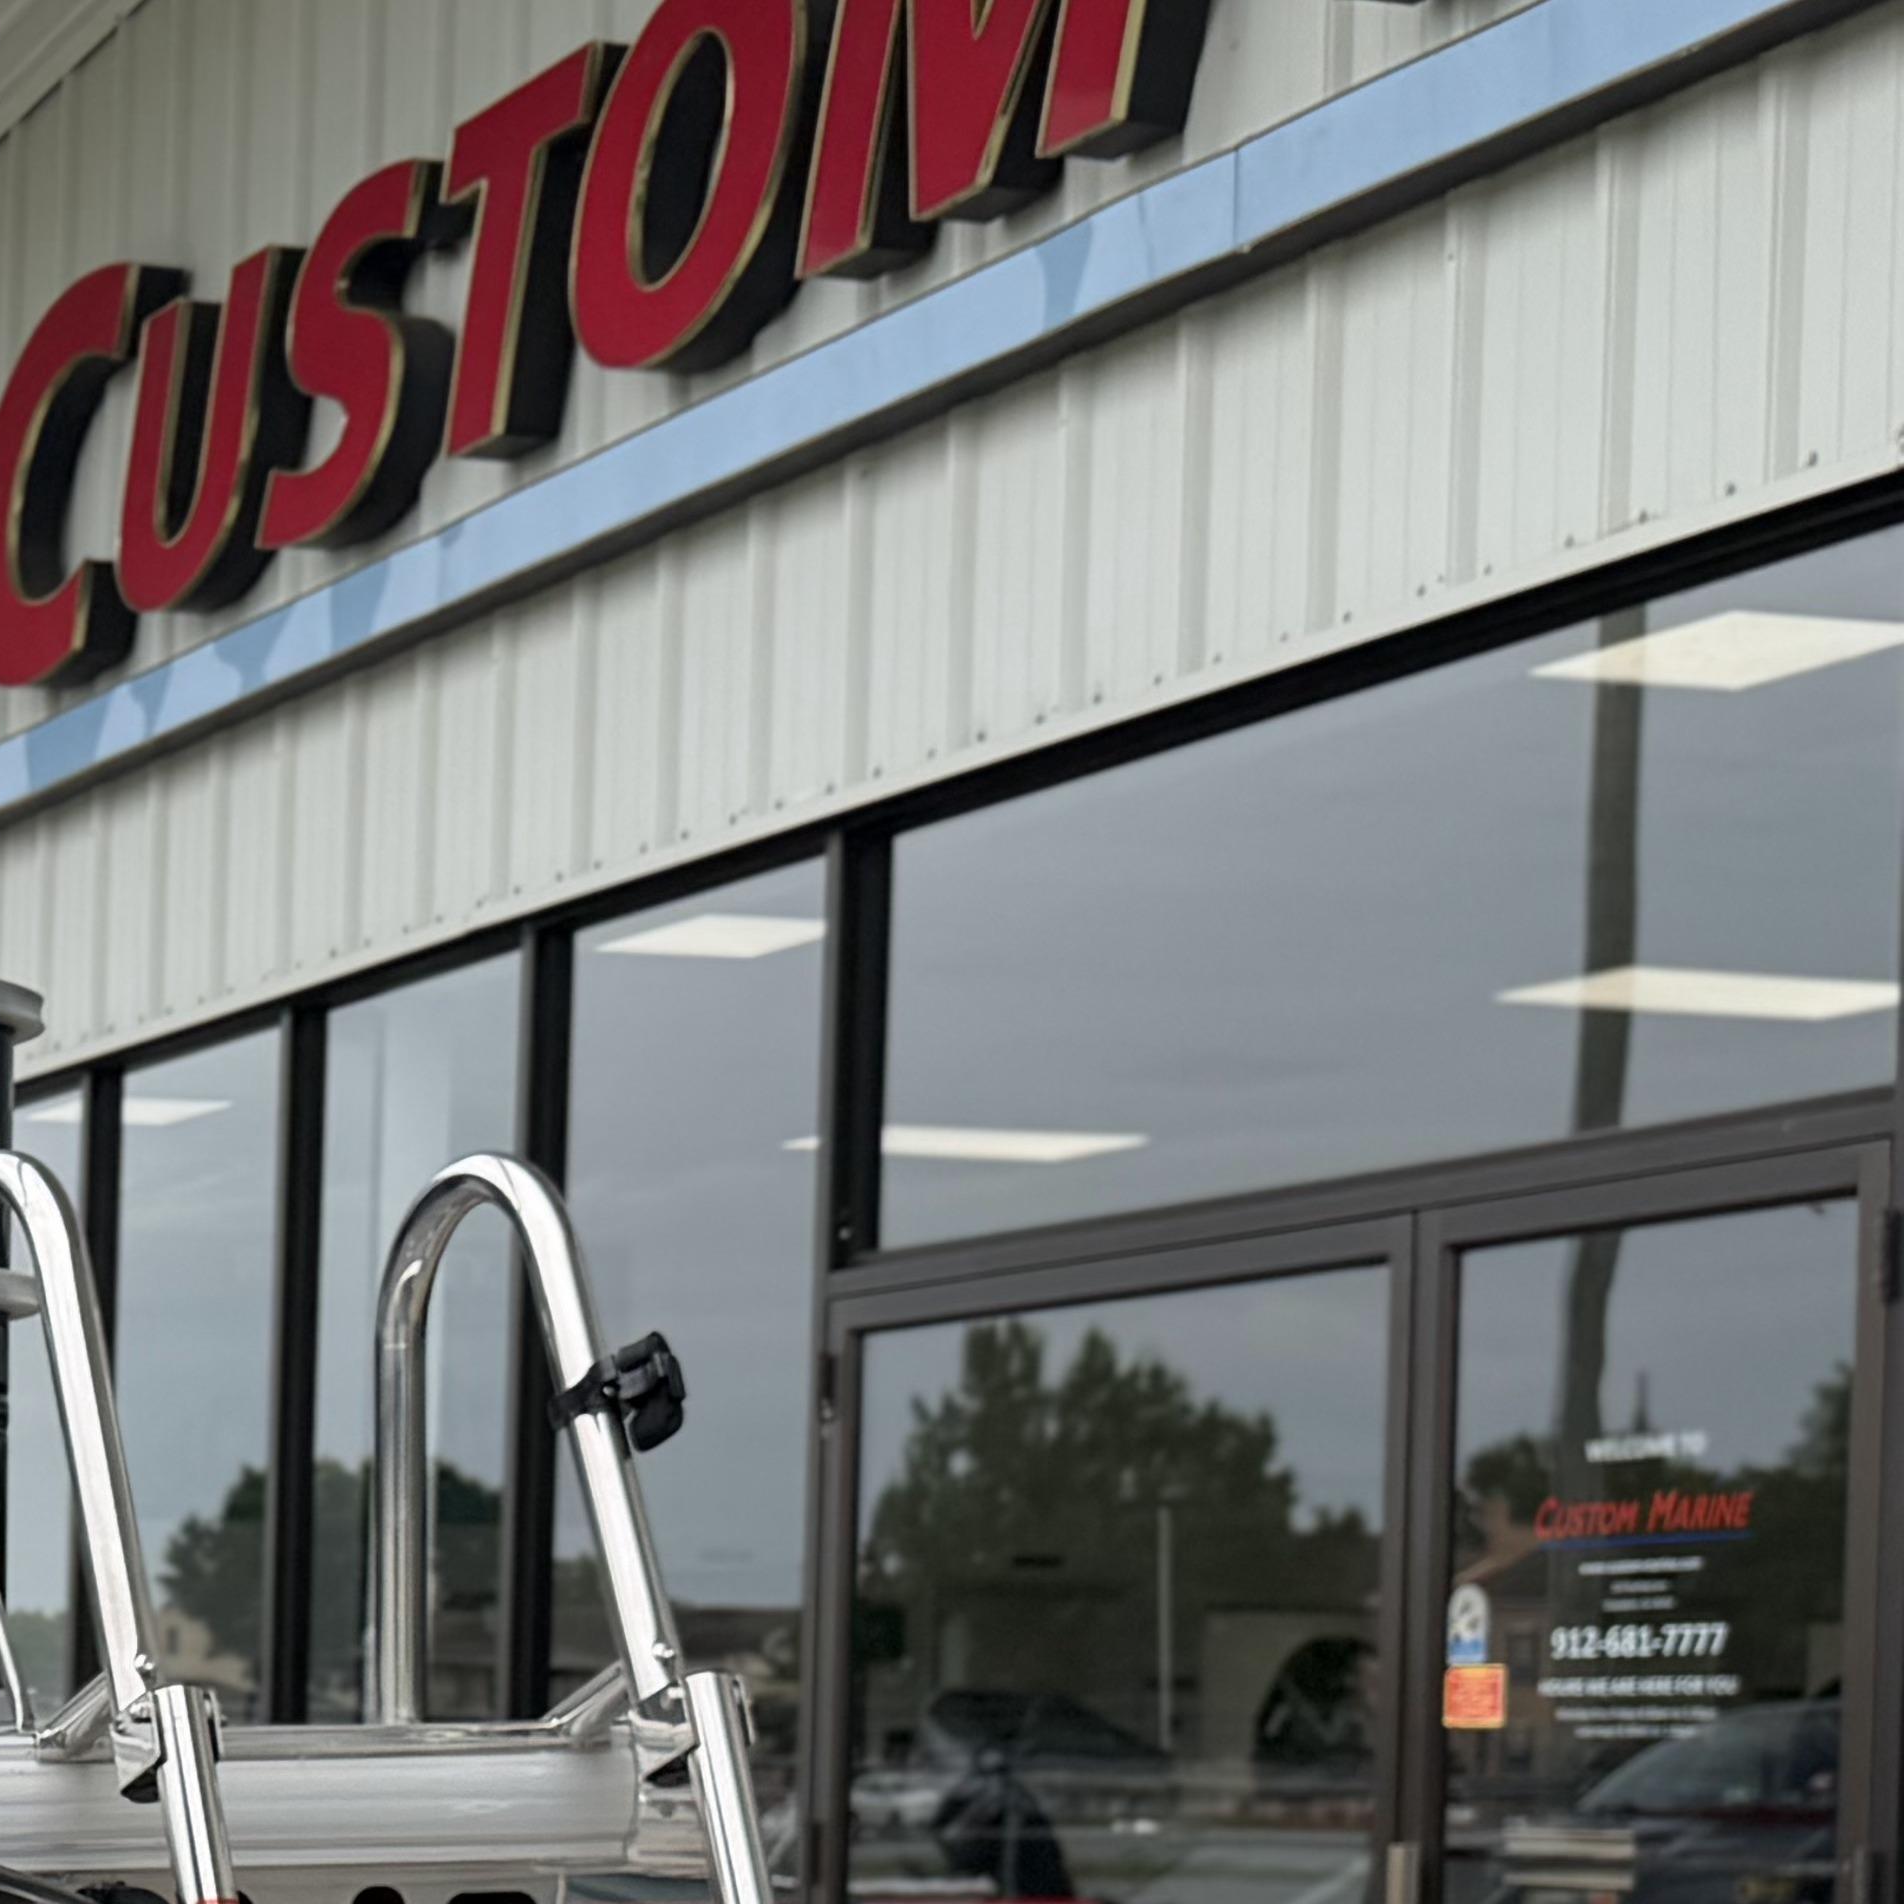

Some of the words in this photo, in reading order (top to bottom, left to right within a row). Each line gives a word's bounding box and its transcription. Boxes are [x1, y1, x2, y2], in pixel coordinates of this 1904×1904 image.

[1533, 1497, 1639, 1538] CUSTOM
[1647, 1489, 1755, 1531] MARINE
[1550, 1622, 1732, 1660] 912-681-7777
